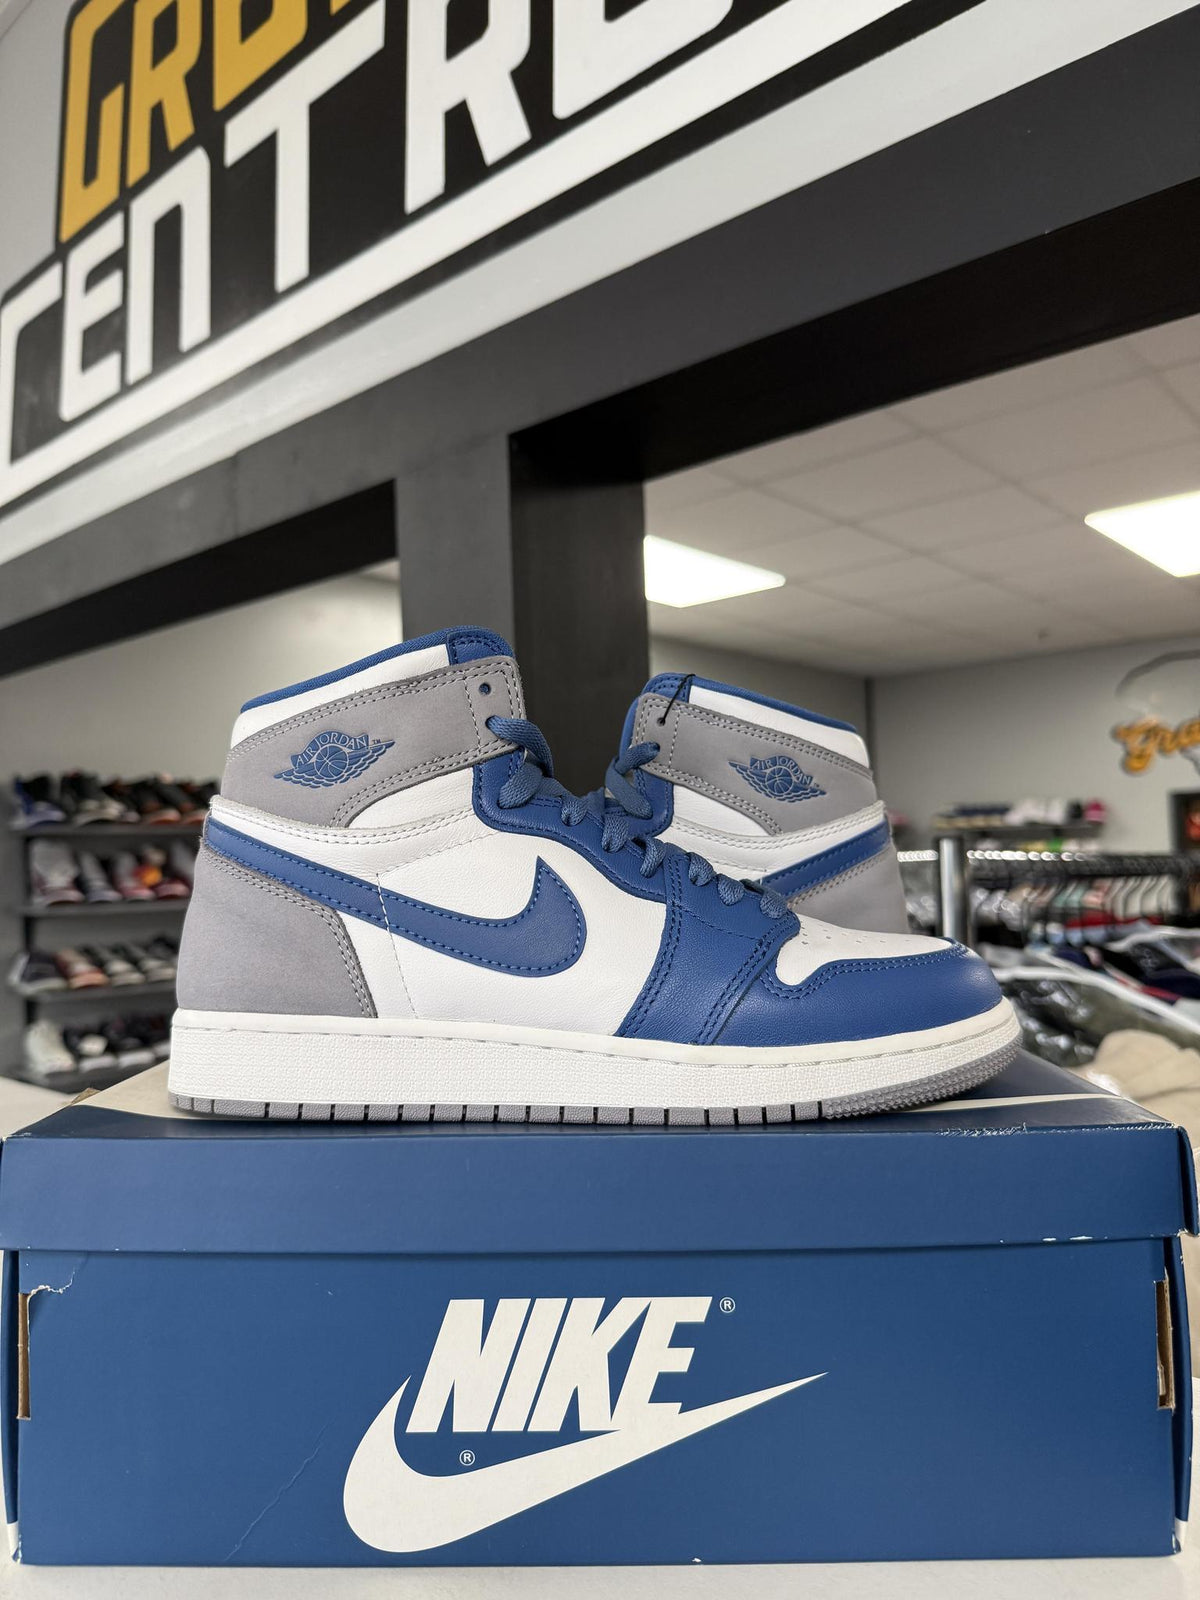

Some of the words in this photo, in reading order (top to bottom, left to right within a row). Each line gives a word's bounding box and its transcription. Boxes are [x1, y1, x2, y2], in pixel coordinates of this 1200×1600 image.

[295, 745, 317, 767] AIR
[315, 731, 369, 751] JORDAN
[752, 760, 774, 770] AIR
[775, 756, 812, 786] JORDAN
[405, 1296, 713, 1433] NIKE
